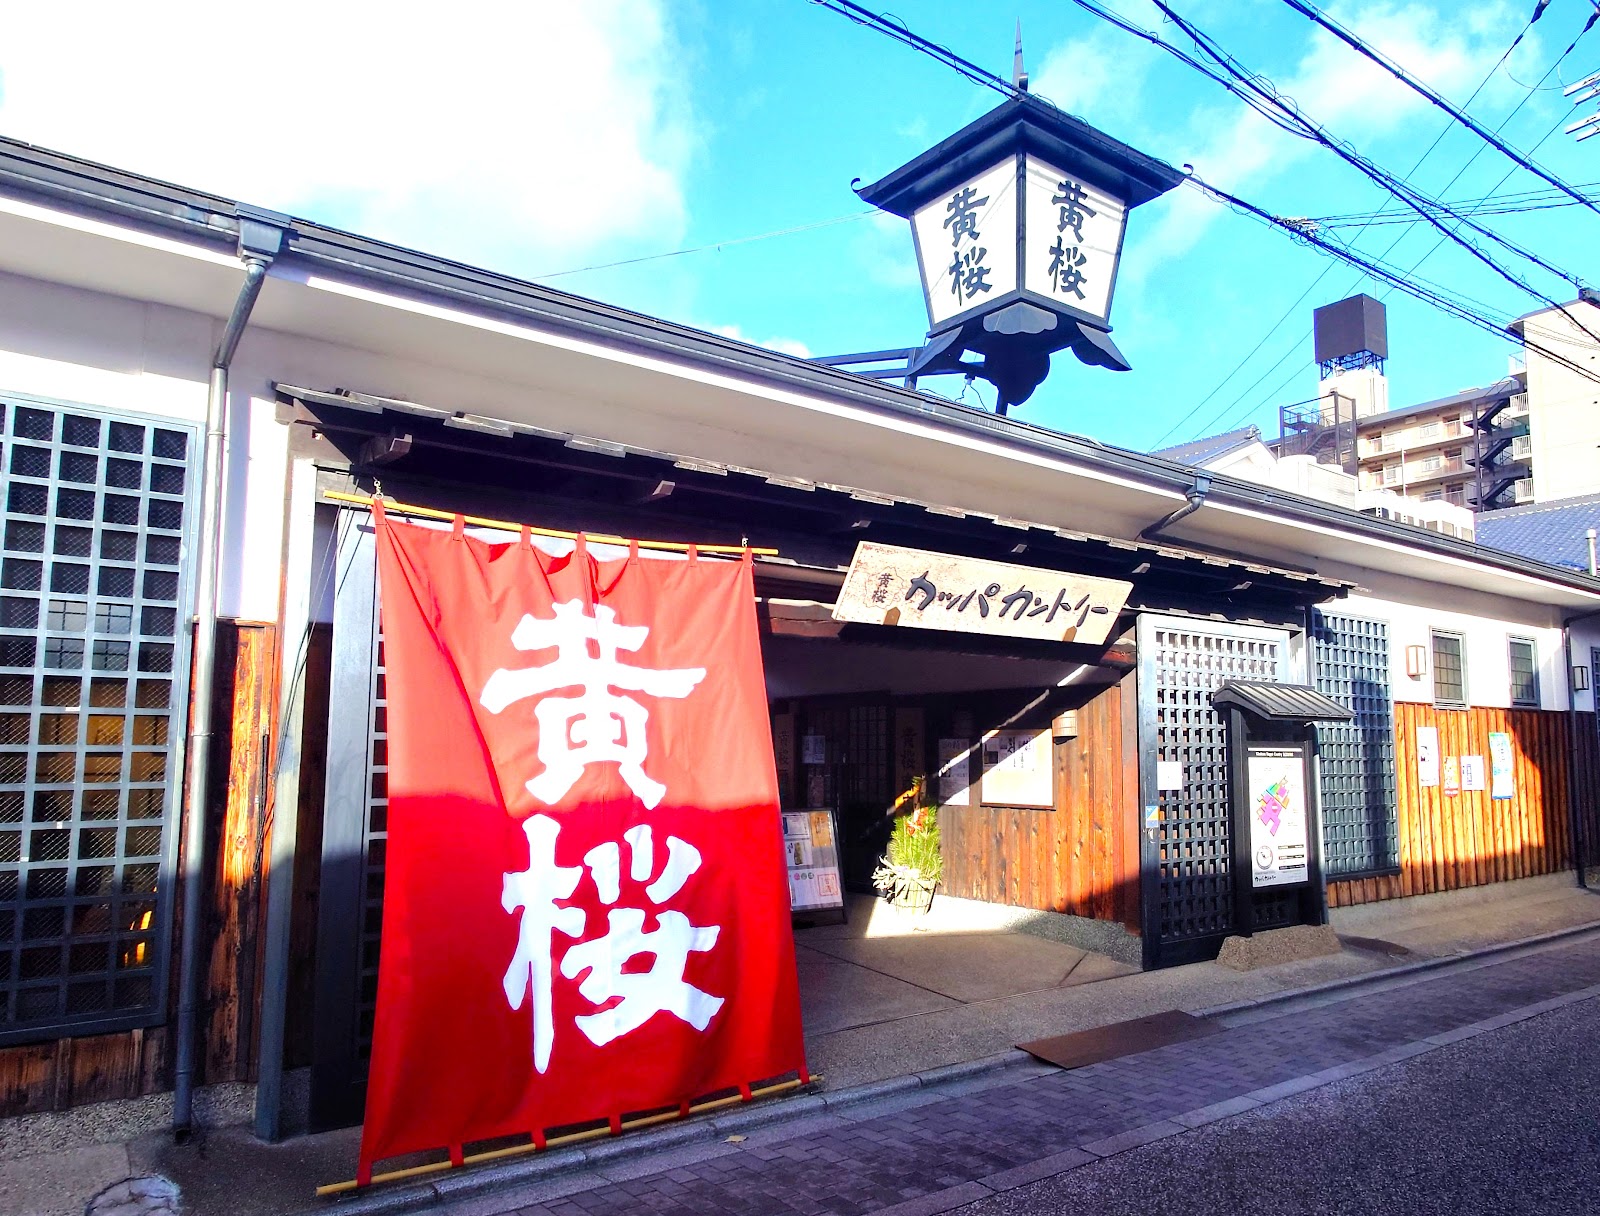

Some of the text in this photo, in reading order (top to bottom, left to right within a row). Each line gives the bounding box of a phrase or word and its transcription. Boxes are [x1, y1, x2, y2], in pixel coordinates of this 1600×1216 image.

[943, 187, 992, 306] 黄桜
[1048, 181, 1097, 300] 黄桜
[871, 573, 894, 604] 黄桜
[905, 570, 1109, 628] カッパカントリー
[479, 599, 725, 1075] 黄桜
